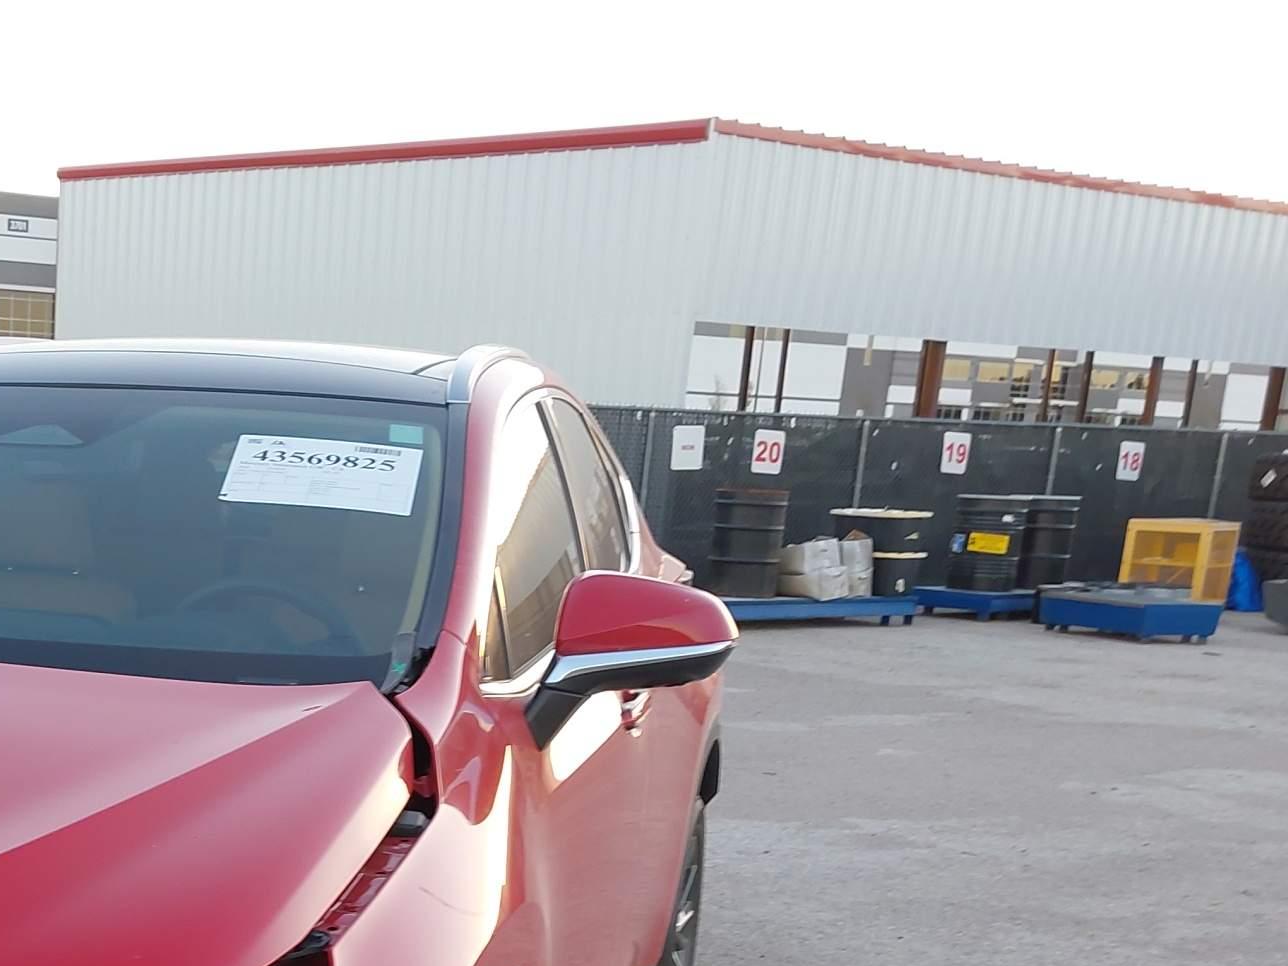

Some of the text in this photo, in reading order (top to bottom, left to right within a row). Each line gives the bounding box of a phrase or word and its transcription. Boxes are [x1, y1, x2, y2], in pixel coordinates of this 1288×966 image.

[252, 449, 397, 472] 43569825
[755, 441, 781, 464] 20
[945, 441, 966, 464] 19
[1121, 451, 1141, 471] 18
